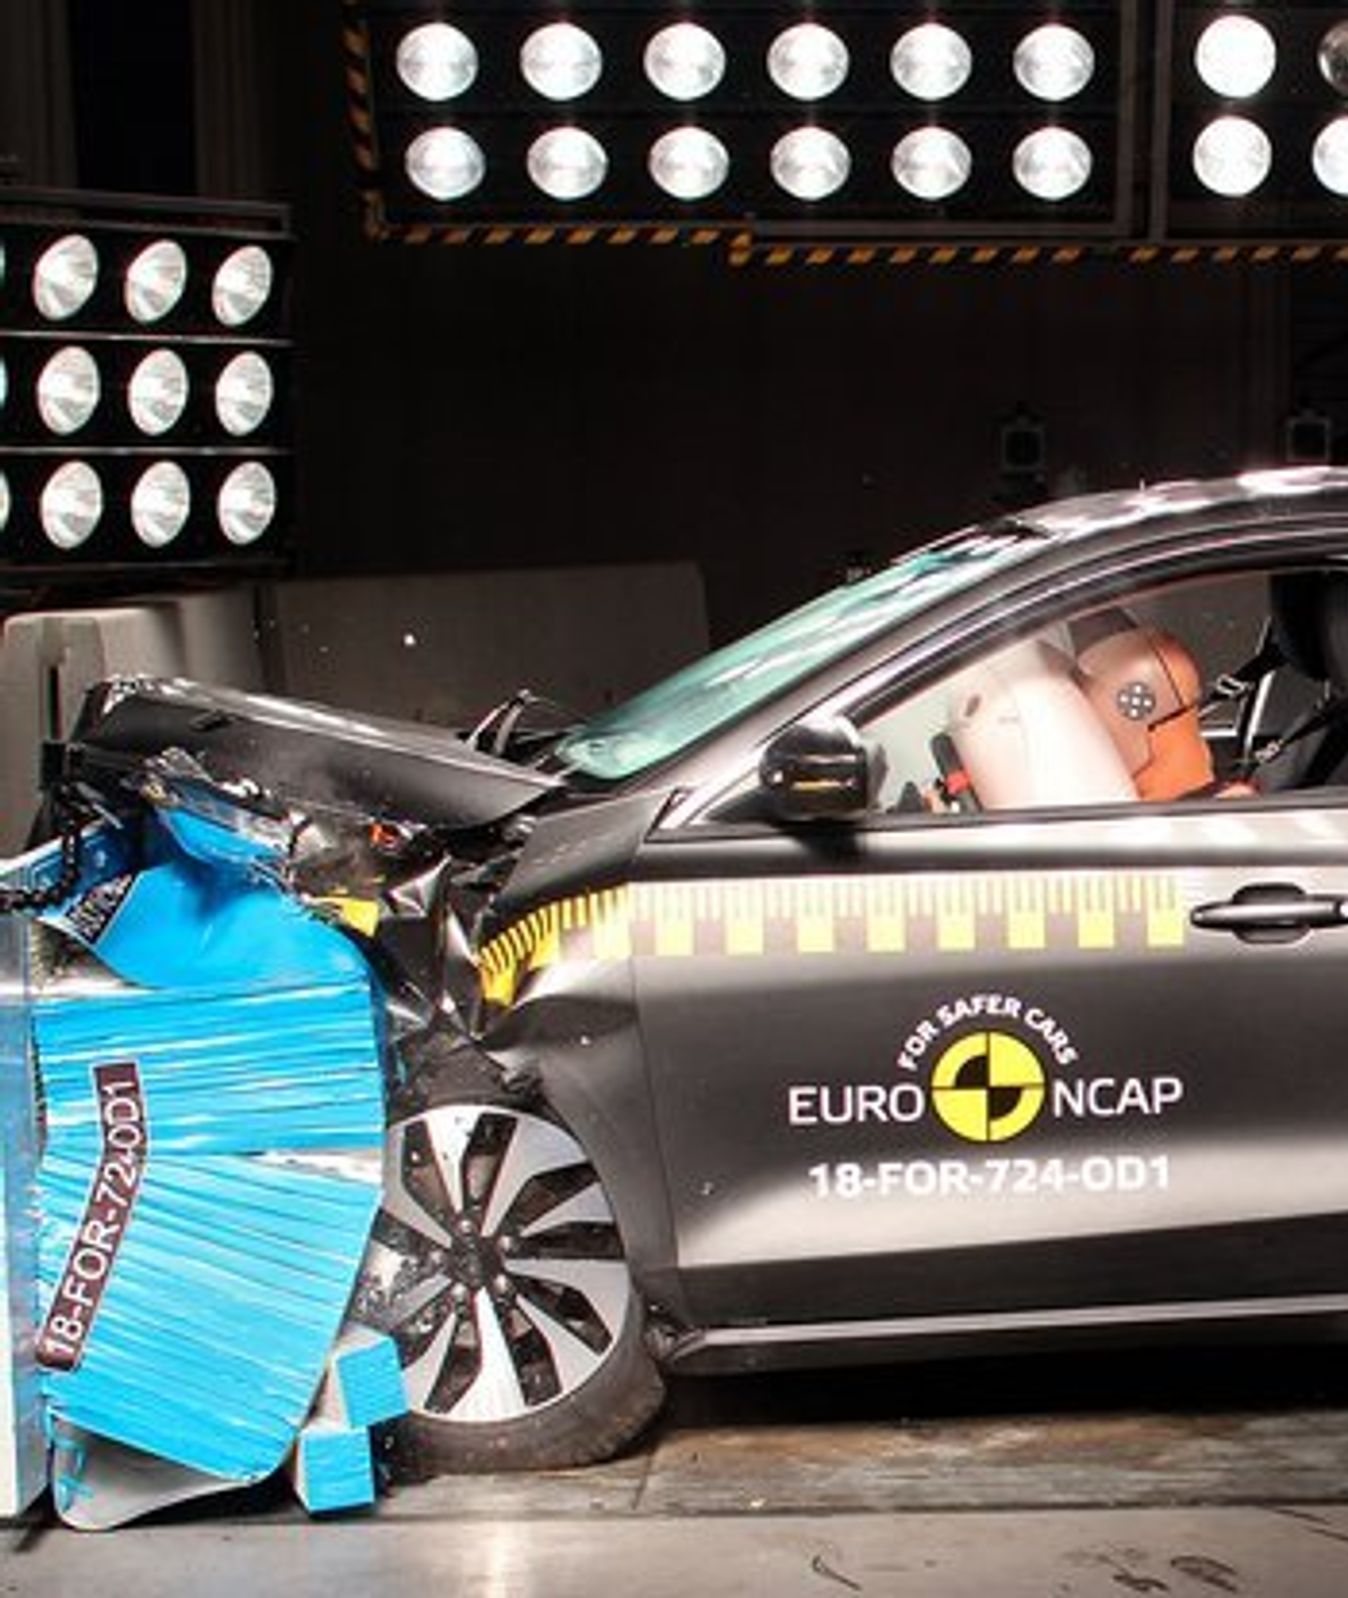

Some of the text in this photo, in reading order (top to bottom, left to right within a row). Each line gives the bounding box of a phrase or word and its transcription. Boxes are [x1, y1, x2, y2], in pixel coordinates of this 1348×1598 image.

[898, 993, 1080, 1072] FOR SAFER CARS
[788, 1076, 1184, 1125] EURO NCAP
